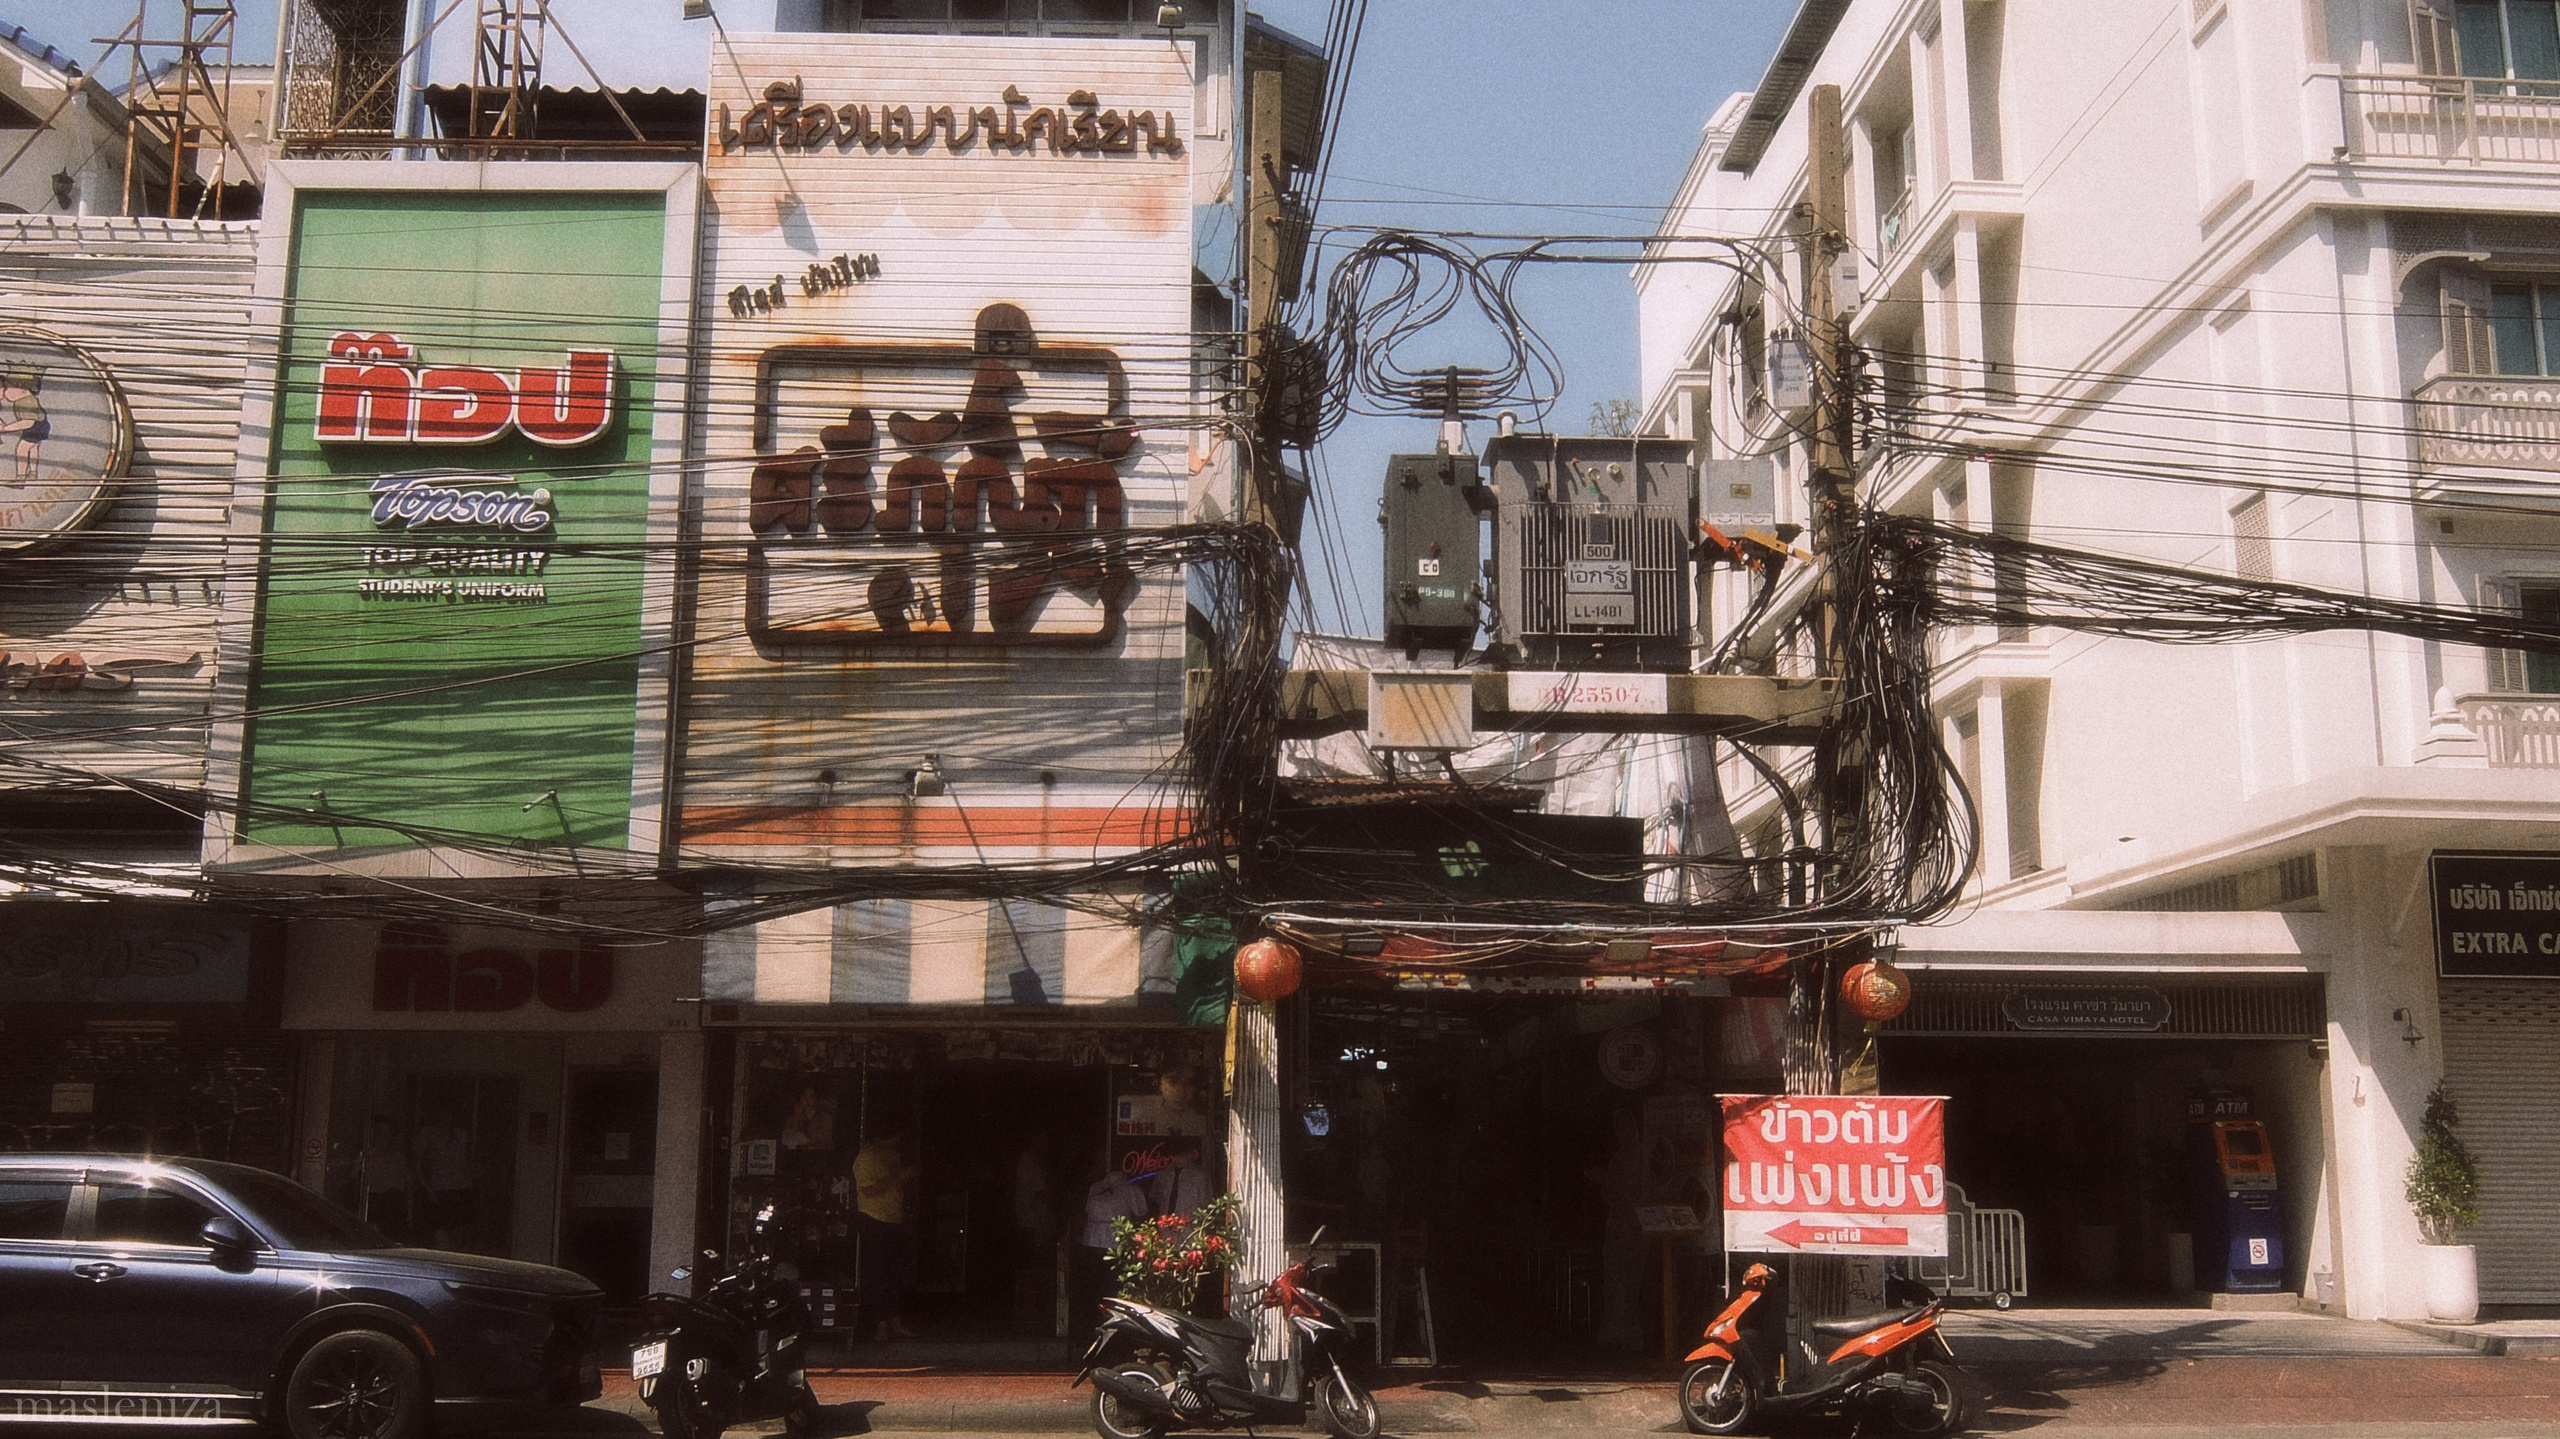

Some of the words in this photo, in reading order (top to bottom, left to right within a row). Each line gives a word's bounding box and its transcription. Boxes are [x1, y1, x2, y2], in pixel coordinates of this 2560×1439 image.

[719, 75, 1182, 153] เครื่องแบบนักเรียน
[369, 467, 550, 532] Topson
[360, 546, 416, 564] TOP
[425, 547, 546, 570] QUALITY
[1587, 546, 1611, 558] 500
[358, 579, 453, 595] STUDENT'S
[457, 581, 545, 598] UNIFORM
[2449, 882, 2502, 910] บริษัท
[2452, 931, 2529, 954] EXTRA
[2024, 997, 2070, 1012] โรงแรม
[2028, 1015, 2058, 1023] CASA
[2063, 1016, 2106, 1024] VIMAYA
[2109, 1016, 2148, 1025] HOTEL
[2214, 1101, 2248, 1114] ATM
[1760, 1101, 1909, 1144] ข้าวต้ม
[1122, 1141, 1199, 1176] Welco
[1728, 1150, 1944, 1208] เพ่งเพ้ง
